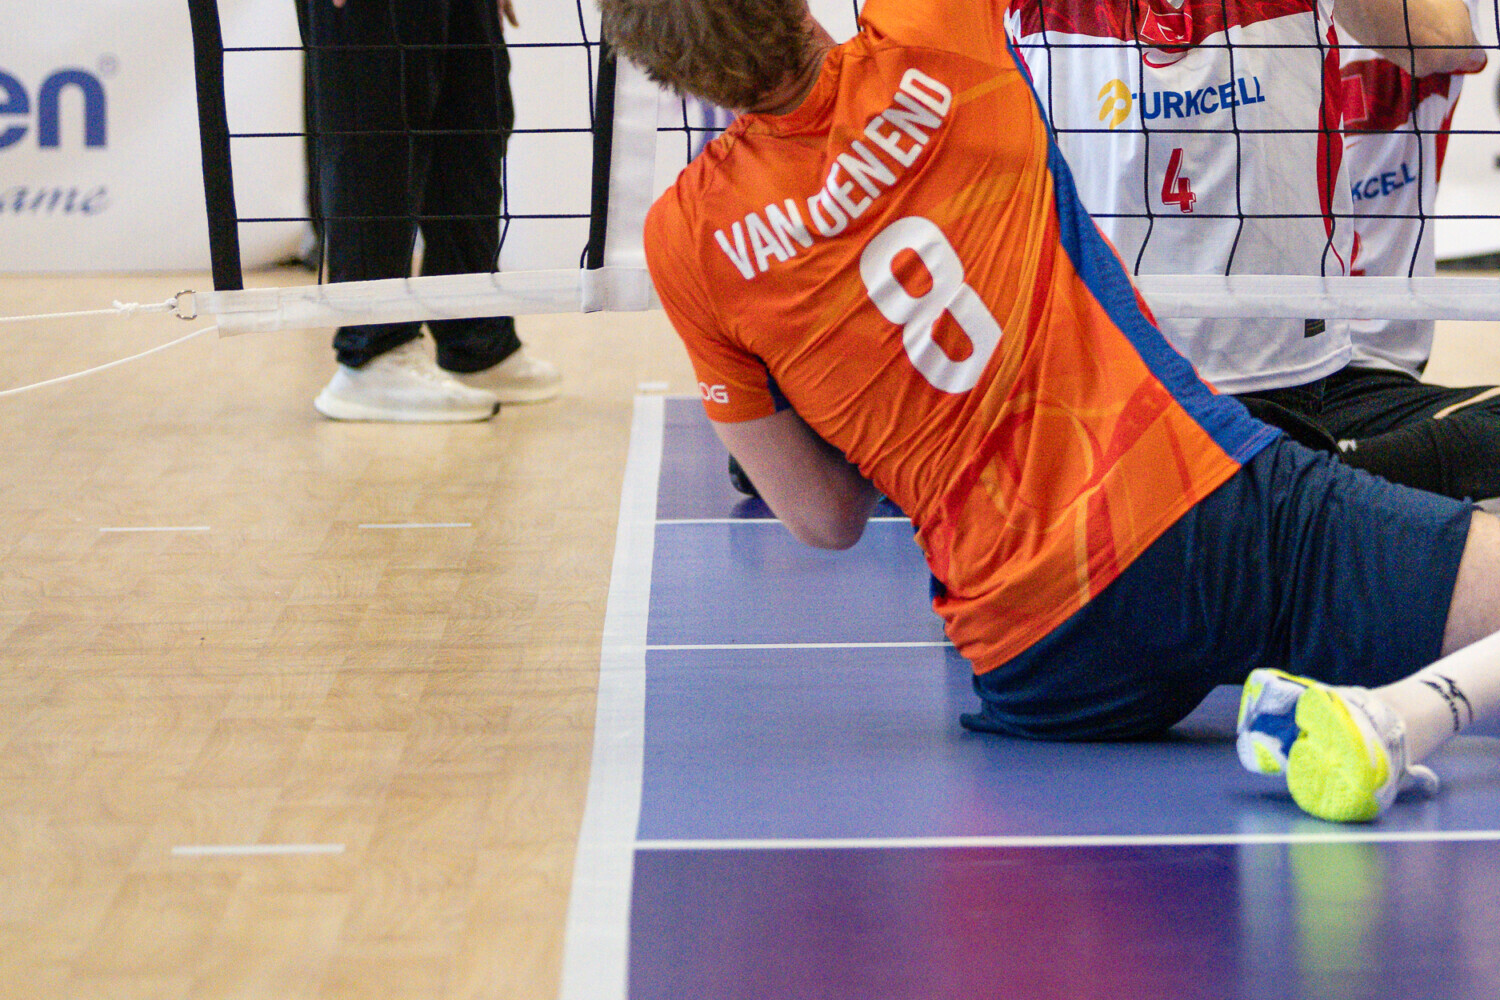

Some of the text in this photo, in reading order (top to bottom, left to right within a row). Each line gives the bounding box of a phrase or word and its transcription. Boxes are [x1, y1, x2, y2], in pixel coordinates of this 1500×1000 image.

[714, 199, 814, 280] VAN
[864, 68, 952, 168] END
[1161, 148, 1197, 213] 4
[859, 216, 1002, 393] 8
